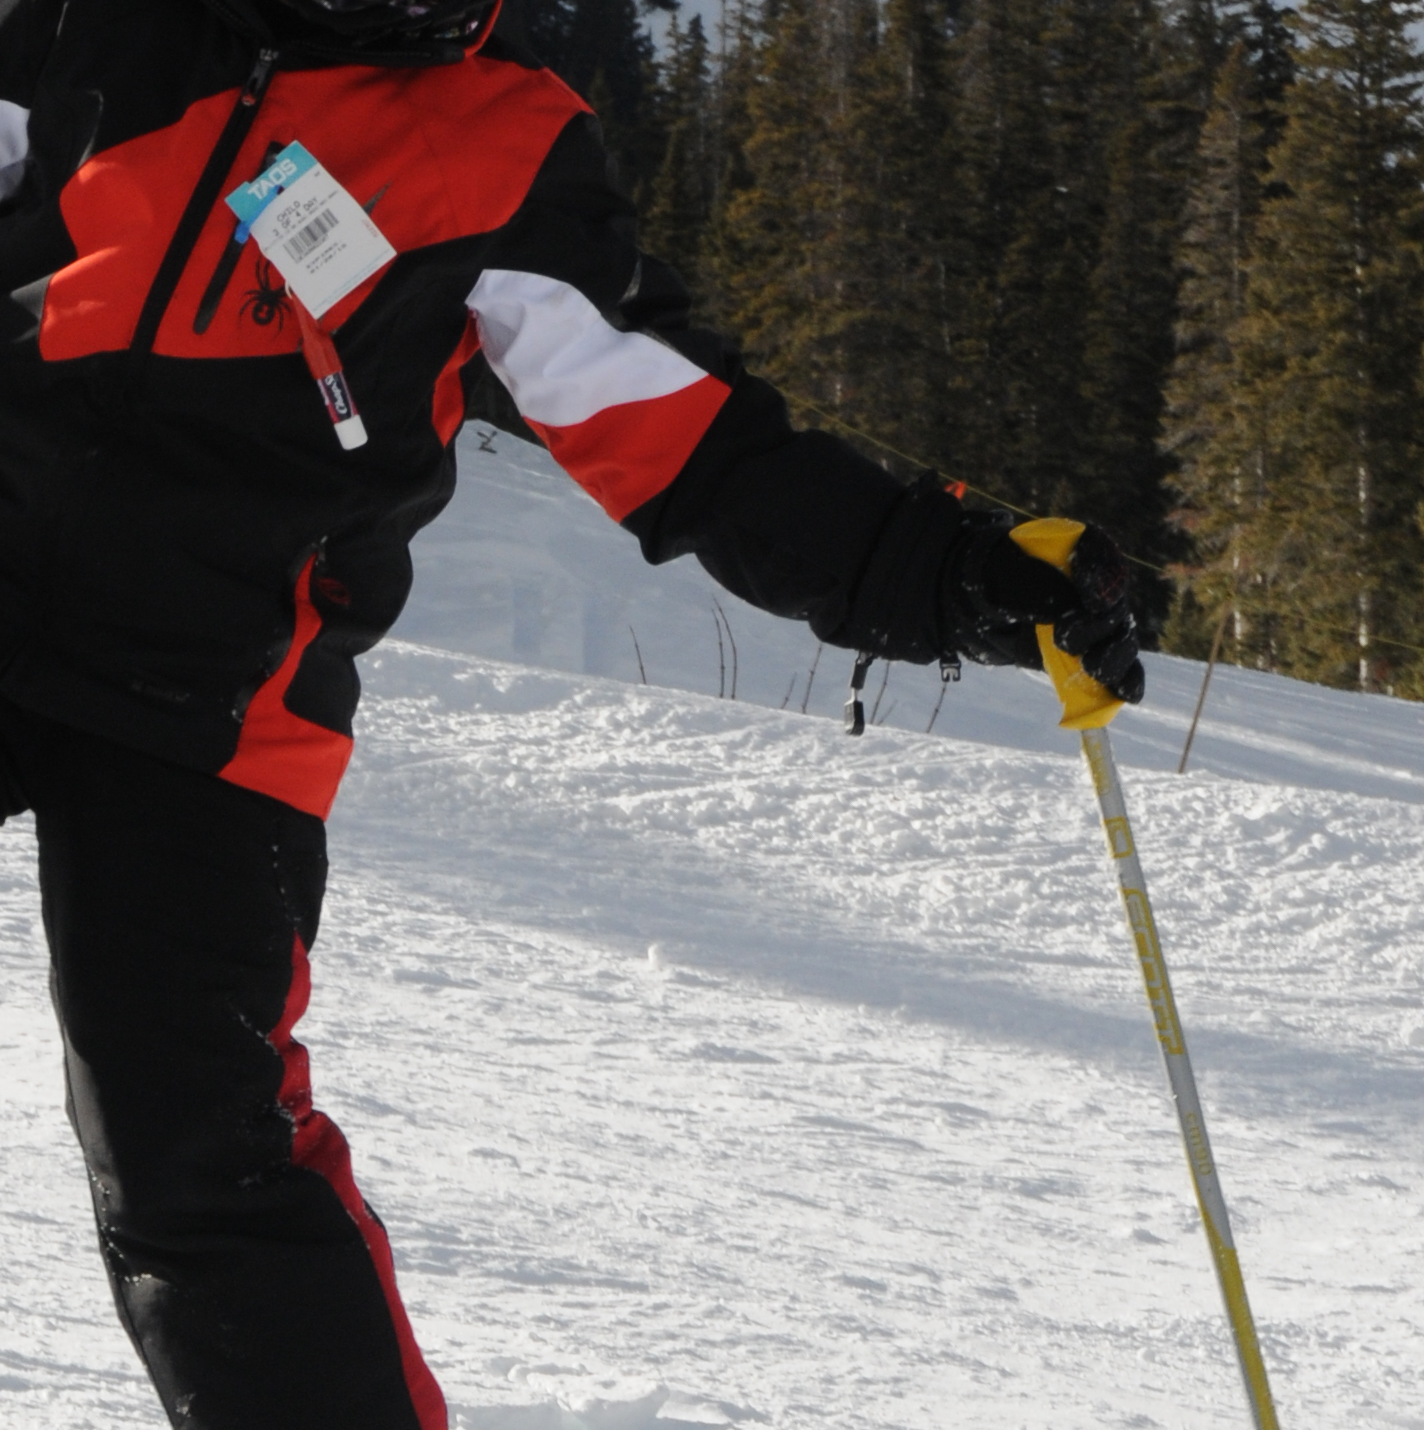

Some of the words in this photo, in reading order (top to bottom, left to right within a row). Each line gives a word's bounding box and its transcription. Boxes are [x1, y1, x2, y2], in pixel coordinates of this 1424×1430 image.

[247, 158, 297, 200] TAOS
[276, 200, 301, 222] CHILD
[281, 219, 292, 230] OF
[303, 197, 319, 212] DAY
[1125, 891, 1182, 1052] SCOTT
